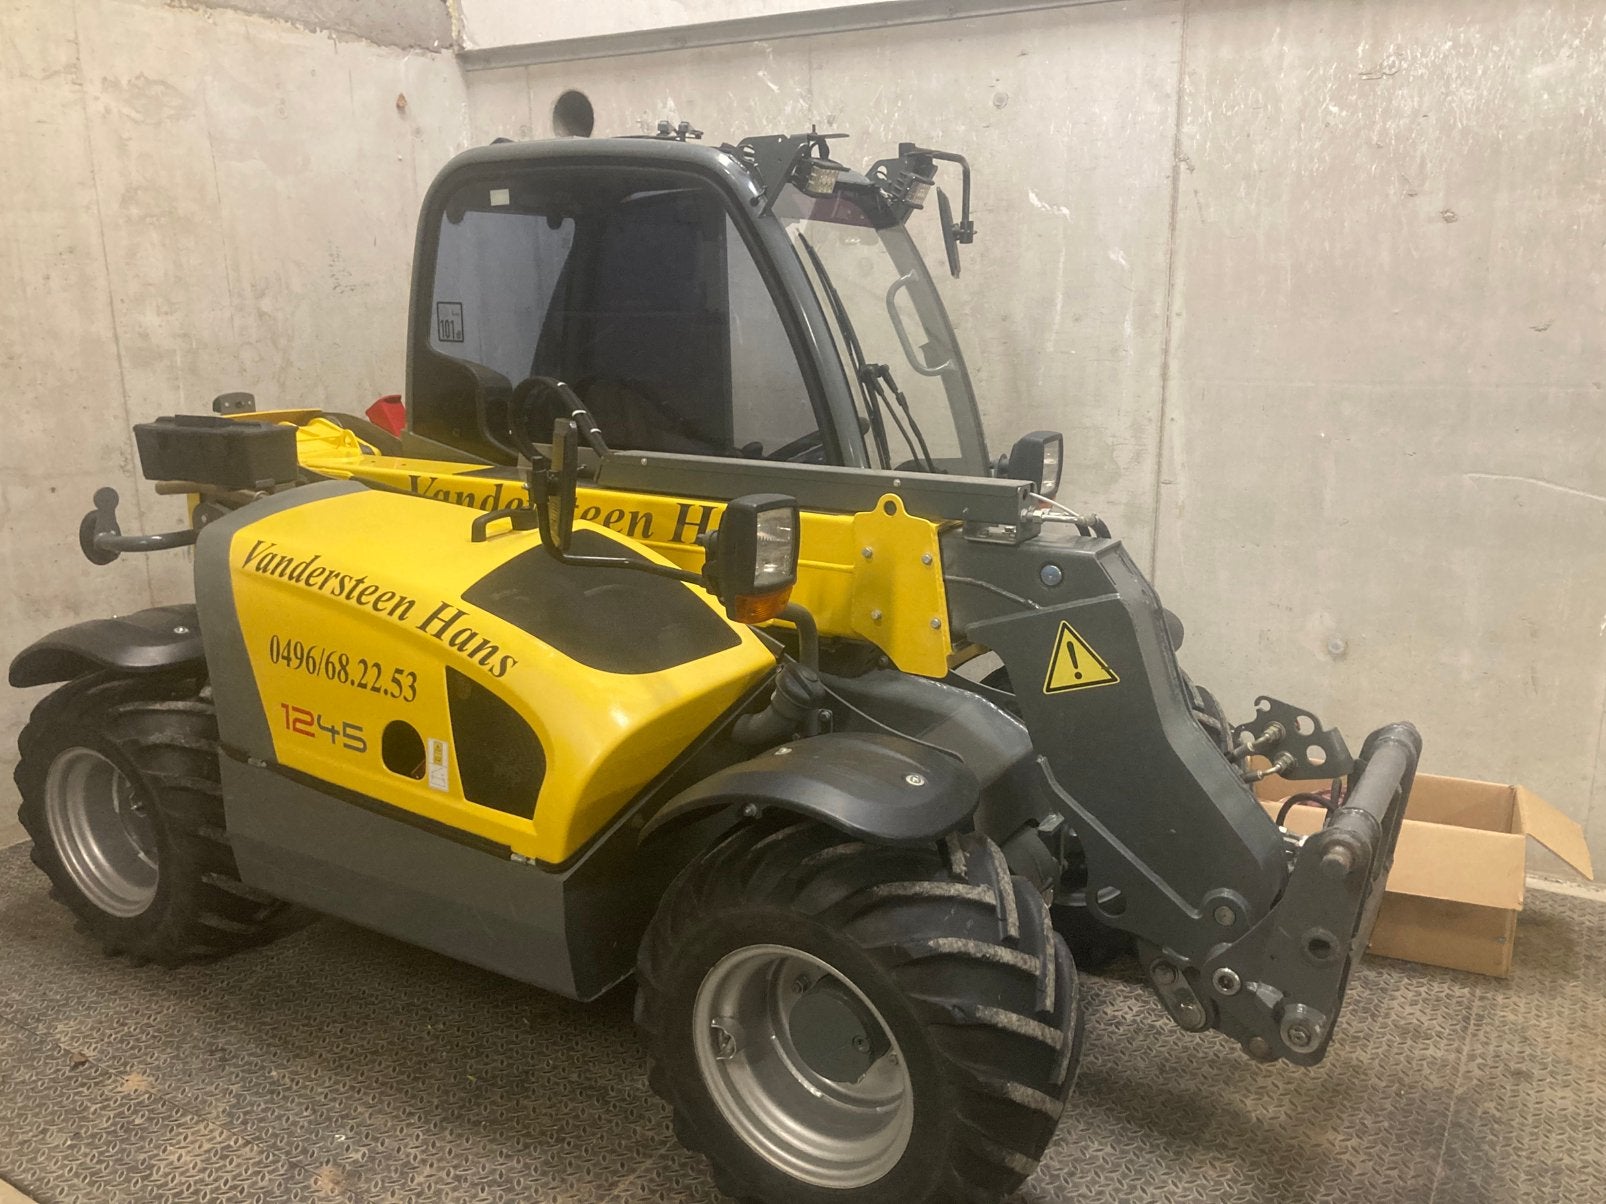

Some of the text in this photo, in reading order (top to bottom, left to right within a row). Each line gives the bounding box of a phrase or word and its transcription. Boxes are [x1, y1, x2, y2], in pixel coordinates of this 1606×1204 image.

[440, 319, 455, 340] 101
[241, 539, 520, 679] Vandersteen Hans
[269, 634, 418, 703] 0496/68.22.53
[280, 702, 368, 754] 1245
